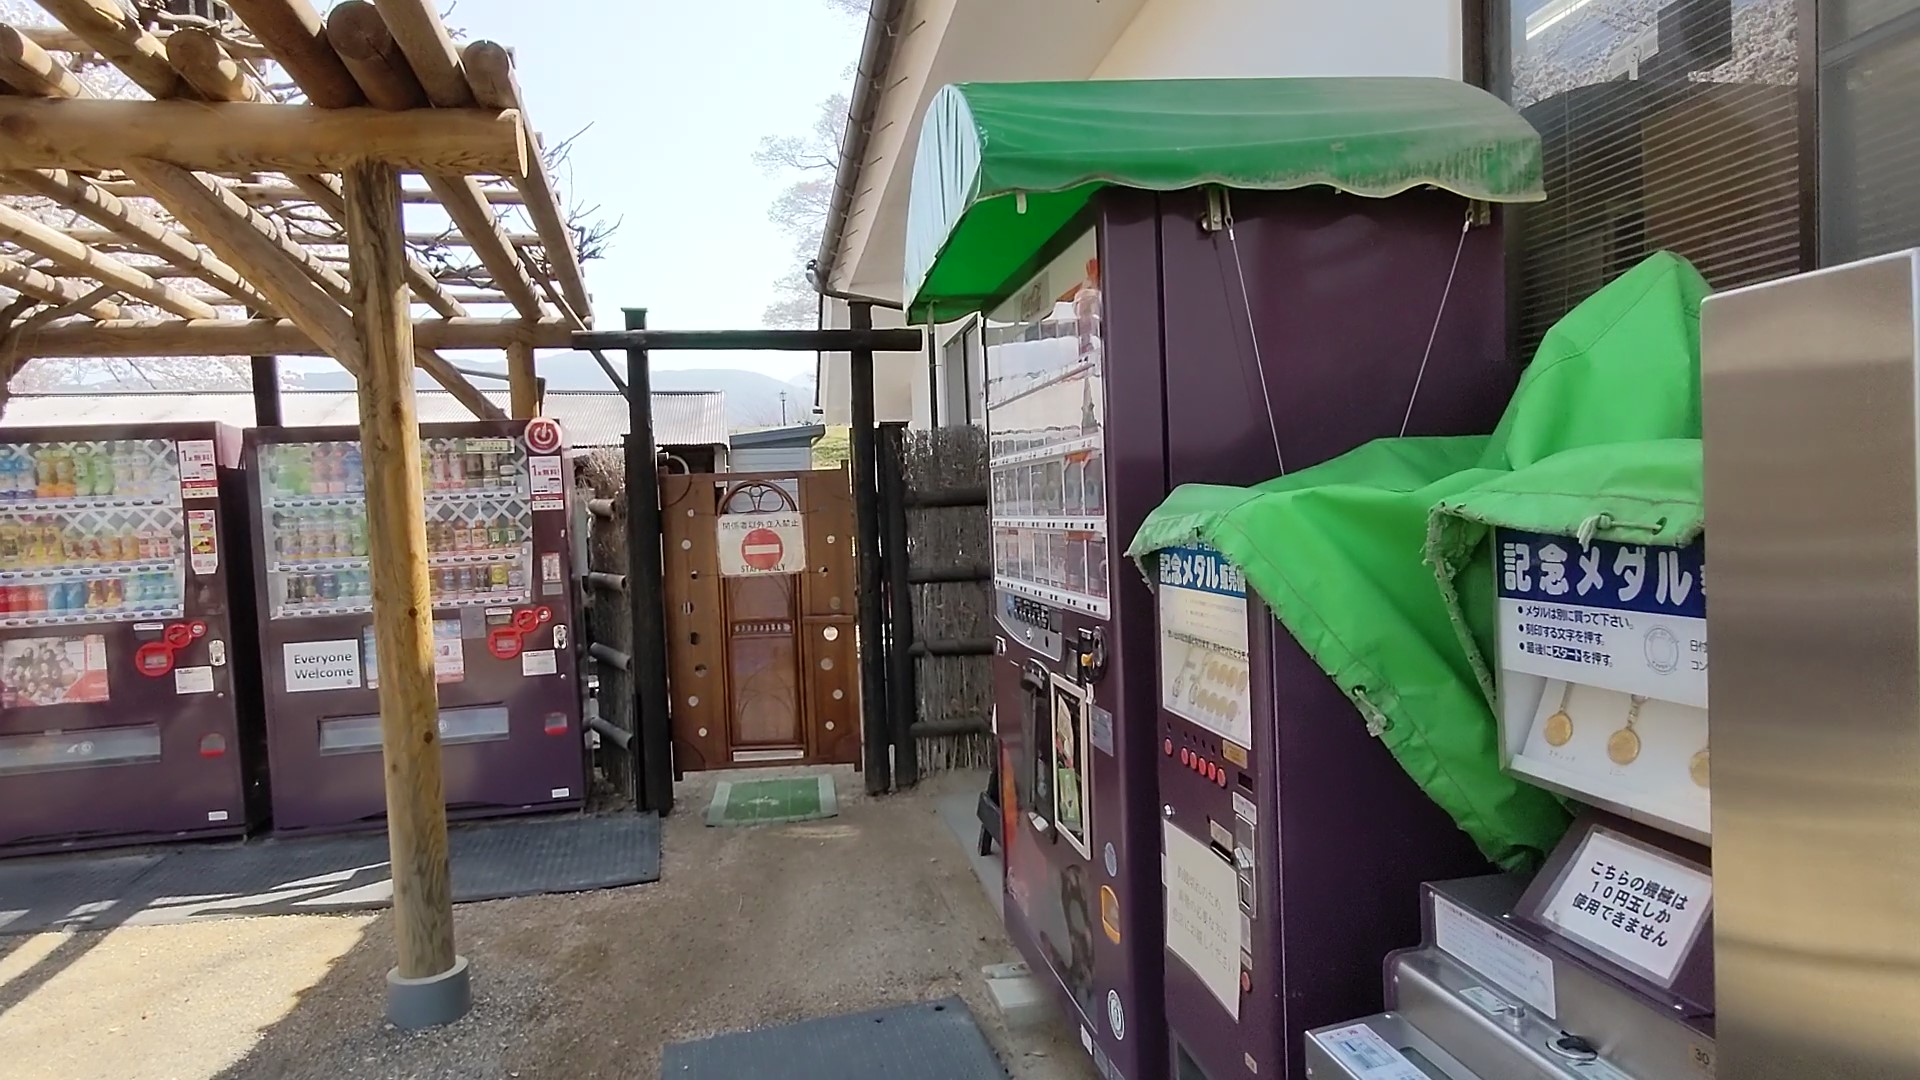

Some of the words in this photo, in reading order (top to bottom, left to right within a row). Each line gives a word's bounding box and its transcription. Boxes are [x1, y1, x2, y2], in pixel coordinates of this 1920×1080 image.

[722, 519, 800, 531] 関係者以外立入禁止
[1503, 542, 1706, 607] 記念メダル
[1526, 605, 1634, 630] メダルは別に買って下さい。
[1526, 623, 1605, 646] 刻印する文字を押す。
[294, 653, 352, 665] Everyone
[1526, 641, 1613, 668] 最後にスタートを押す。
[294, 667, 354, 679] Welcome
[1590, 861, 1689, 911] こちらの機械は
[1591, 881, 1672, 924] 10円玉しか
[1572, 892, 1669, 947] 使用できません
[1695, 1048, 1709, 1065] 30
